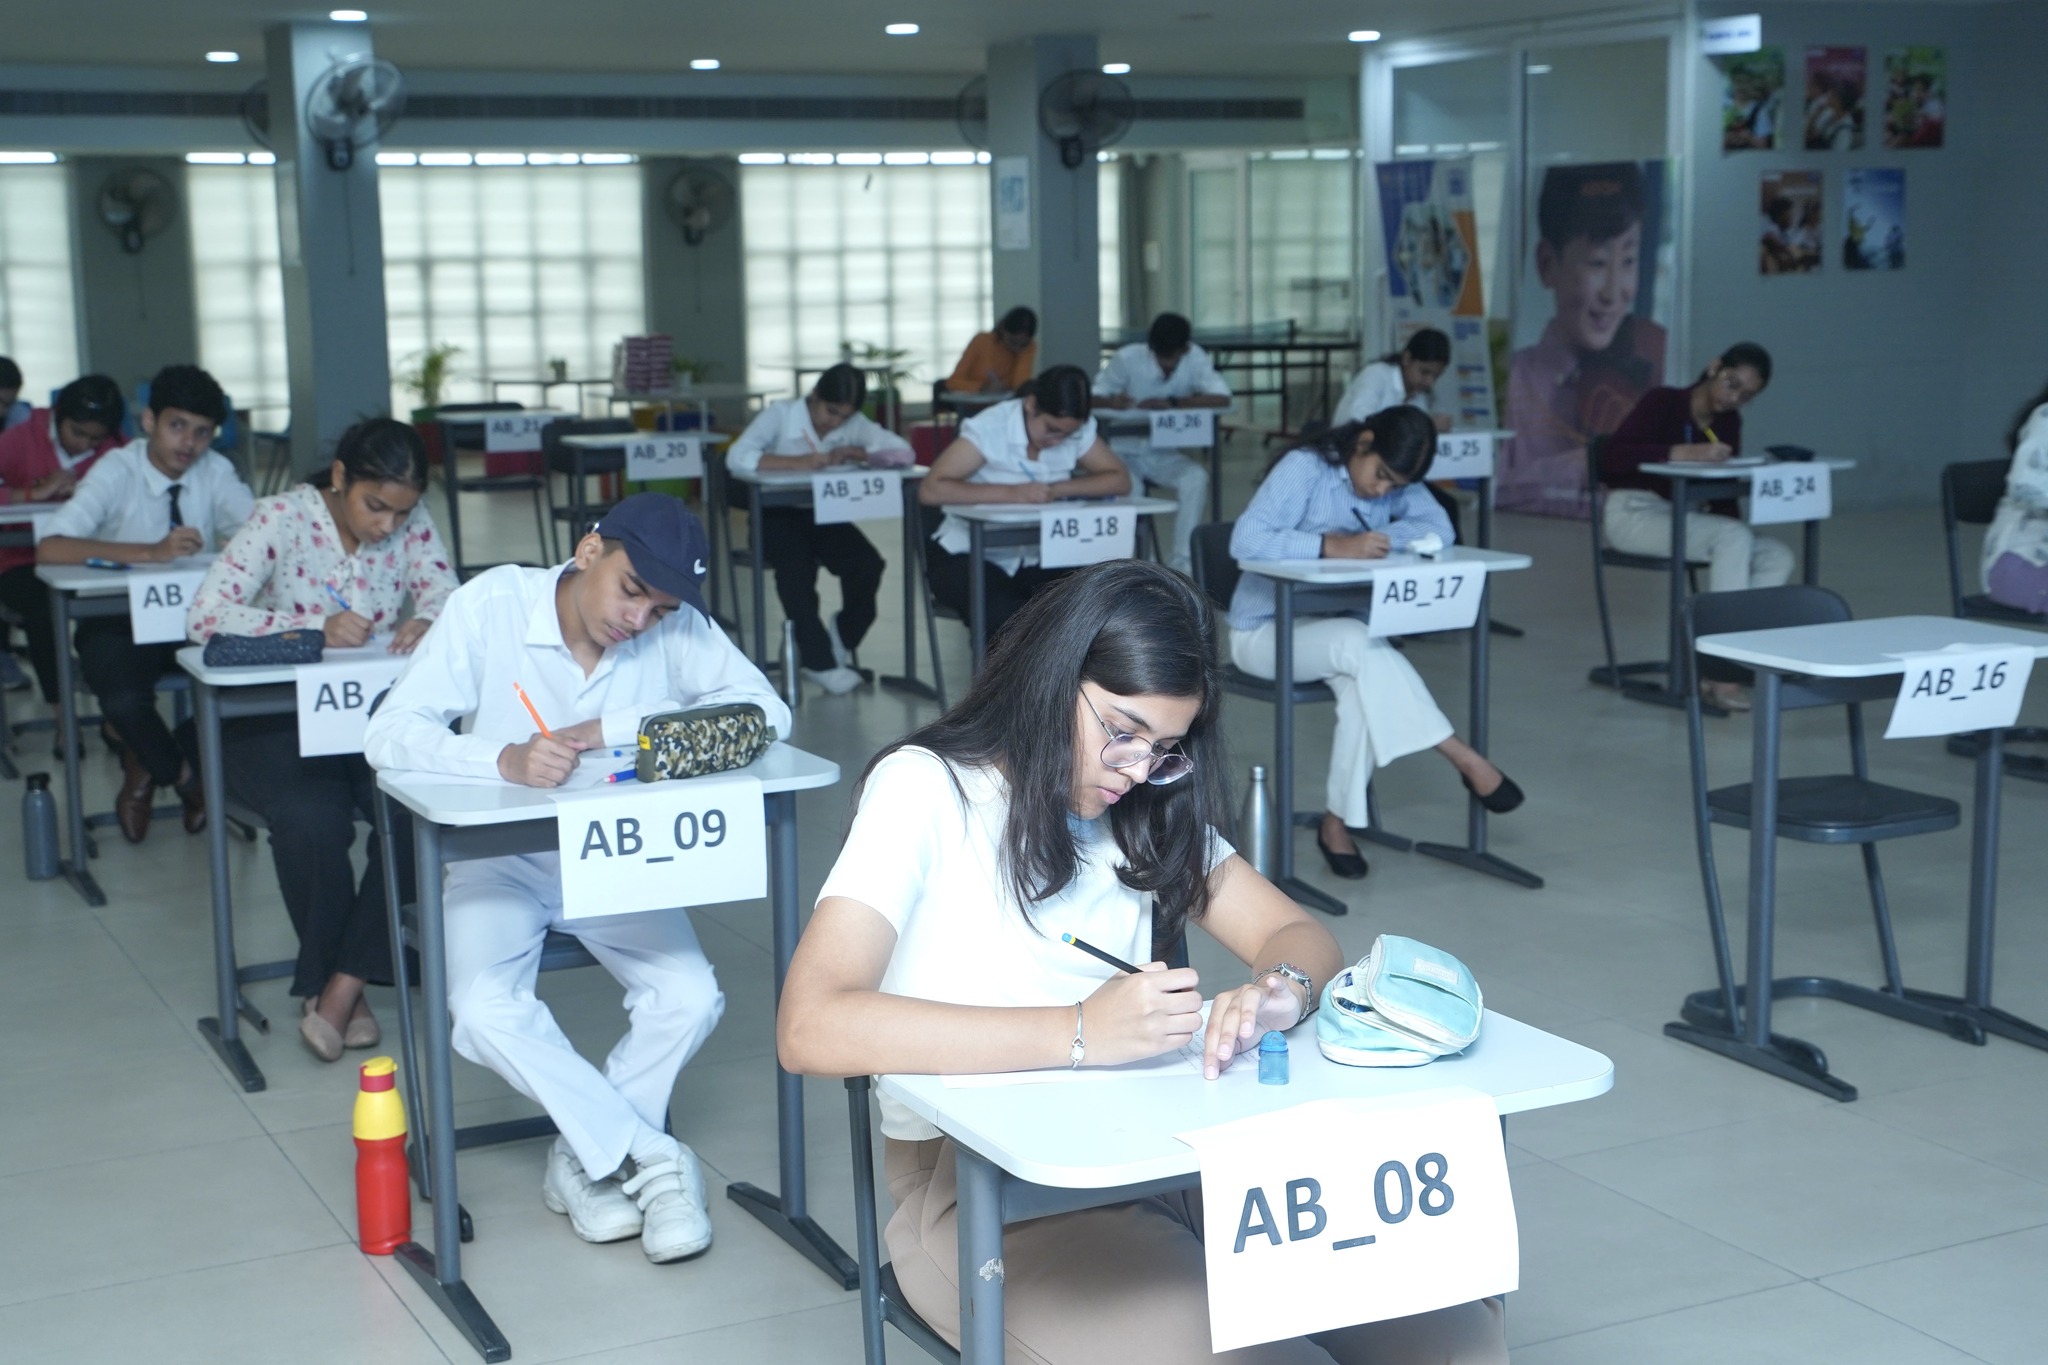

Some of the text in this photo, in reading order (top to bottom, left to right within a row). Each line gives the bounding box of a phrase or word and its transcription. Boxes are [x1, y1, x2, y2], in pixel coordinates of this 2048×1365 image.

[1157, 414, 1202, 432] AB_26
[633, 442, 687, 463] AB_20
[822, 477, 885, 501] AB_19
[1759, 476, 1816, 501] AB_24
[1050, 516, 1118, 543] AB_18
[143, 583, 186, 611] AB
[1382, 575, 1464, 607] AB_17
[1911, 661, 2008, 701] AB_16
[313, 679, 378, 716] AB
[580, 809, 727, 864] AB_09
[1233, 1152, 1455, 1254] AB_08
